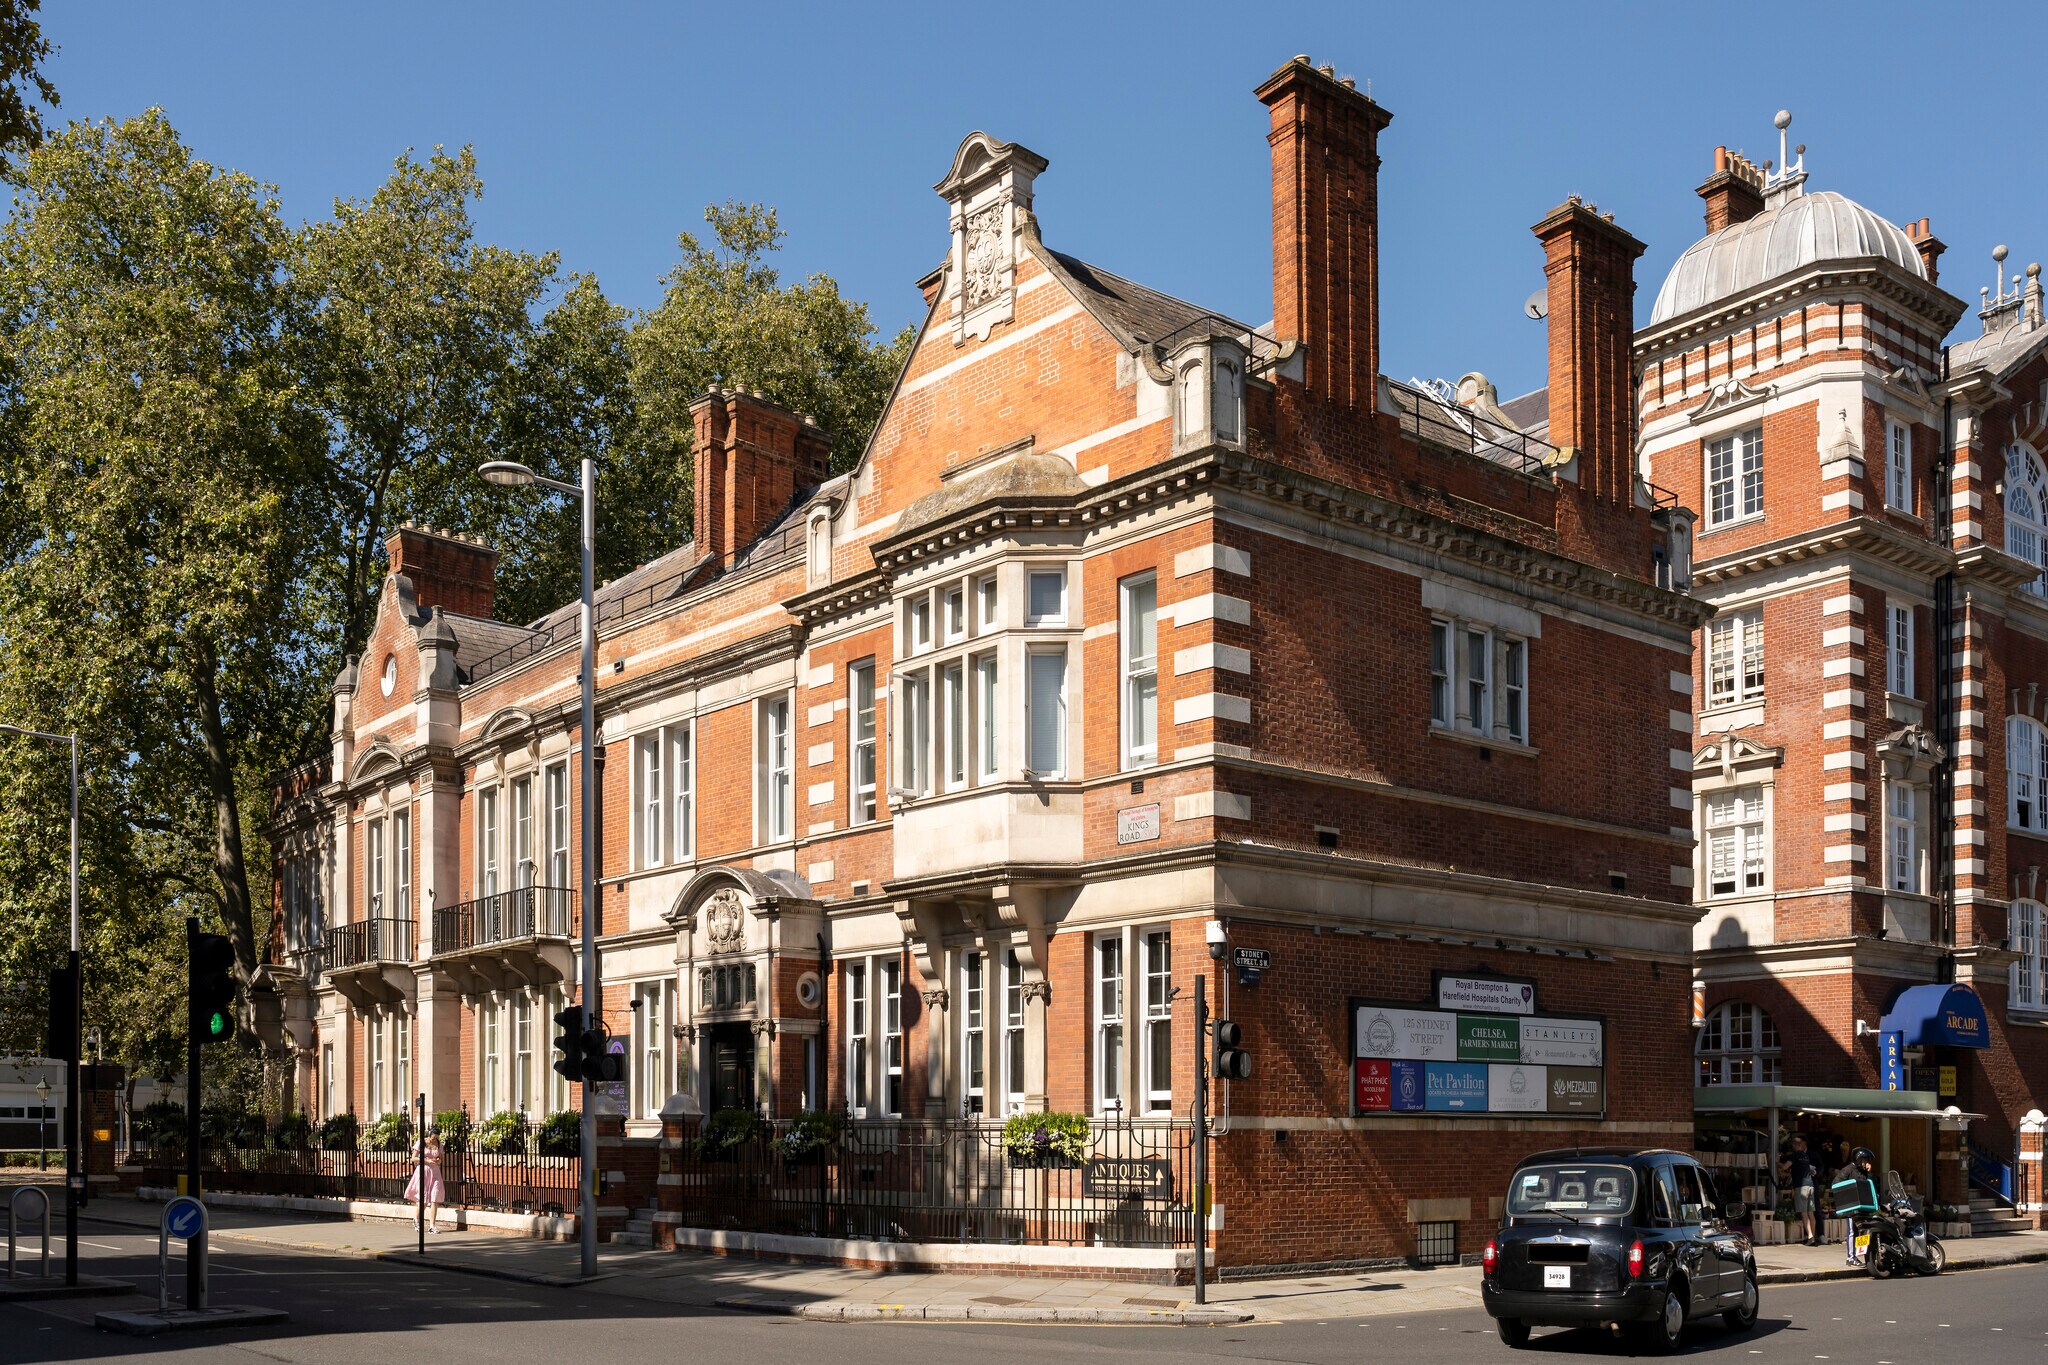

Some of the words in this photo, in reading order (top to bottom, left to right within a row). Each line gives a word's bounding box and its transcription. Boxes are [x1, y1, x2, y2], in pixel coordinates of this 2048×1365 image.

[1128, 820, 1149, 831] KINGS
[1120, 832, 1140, 842] ROAD
[1241, 950, 1263, 958] SYDNEY
[1456, 980, 1472, 990] Royal
[1474, 982, 1503, 992] Brompton
[1505, 984, 1509, 992] &
[1442, 991, 1470, 1001] Harefield
[1472, 994, 1499, 1004] Hospitals
[1501, 996, 1521, 1006] Charity
[1403, 1018, 1415, 1028] 125
[1416, 1019, 1451, 1030] SYDNEY
[1946, 1016, 1979, 1030] ARCADE
[1410, 1033, 1444, 1044] STREET
[1471, 1027, 1506, 1039] CHELSEA
[1460, 1039, 1490, 1048] FARMERS
[1491, 1040, 1518, 1049] MARKET
[1428, 1073, 1443, 1088] Pet
[1446, 1073, 1484, 1089] Pavilion
[1567, 1080, 1597, 1093] MEZCALITO
